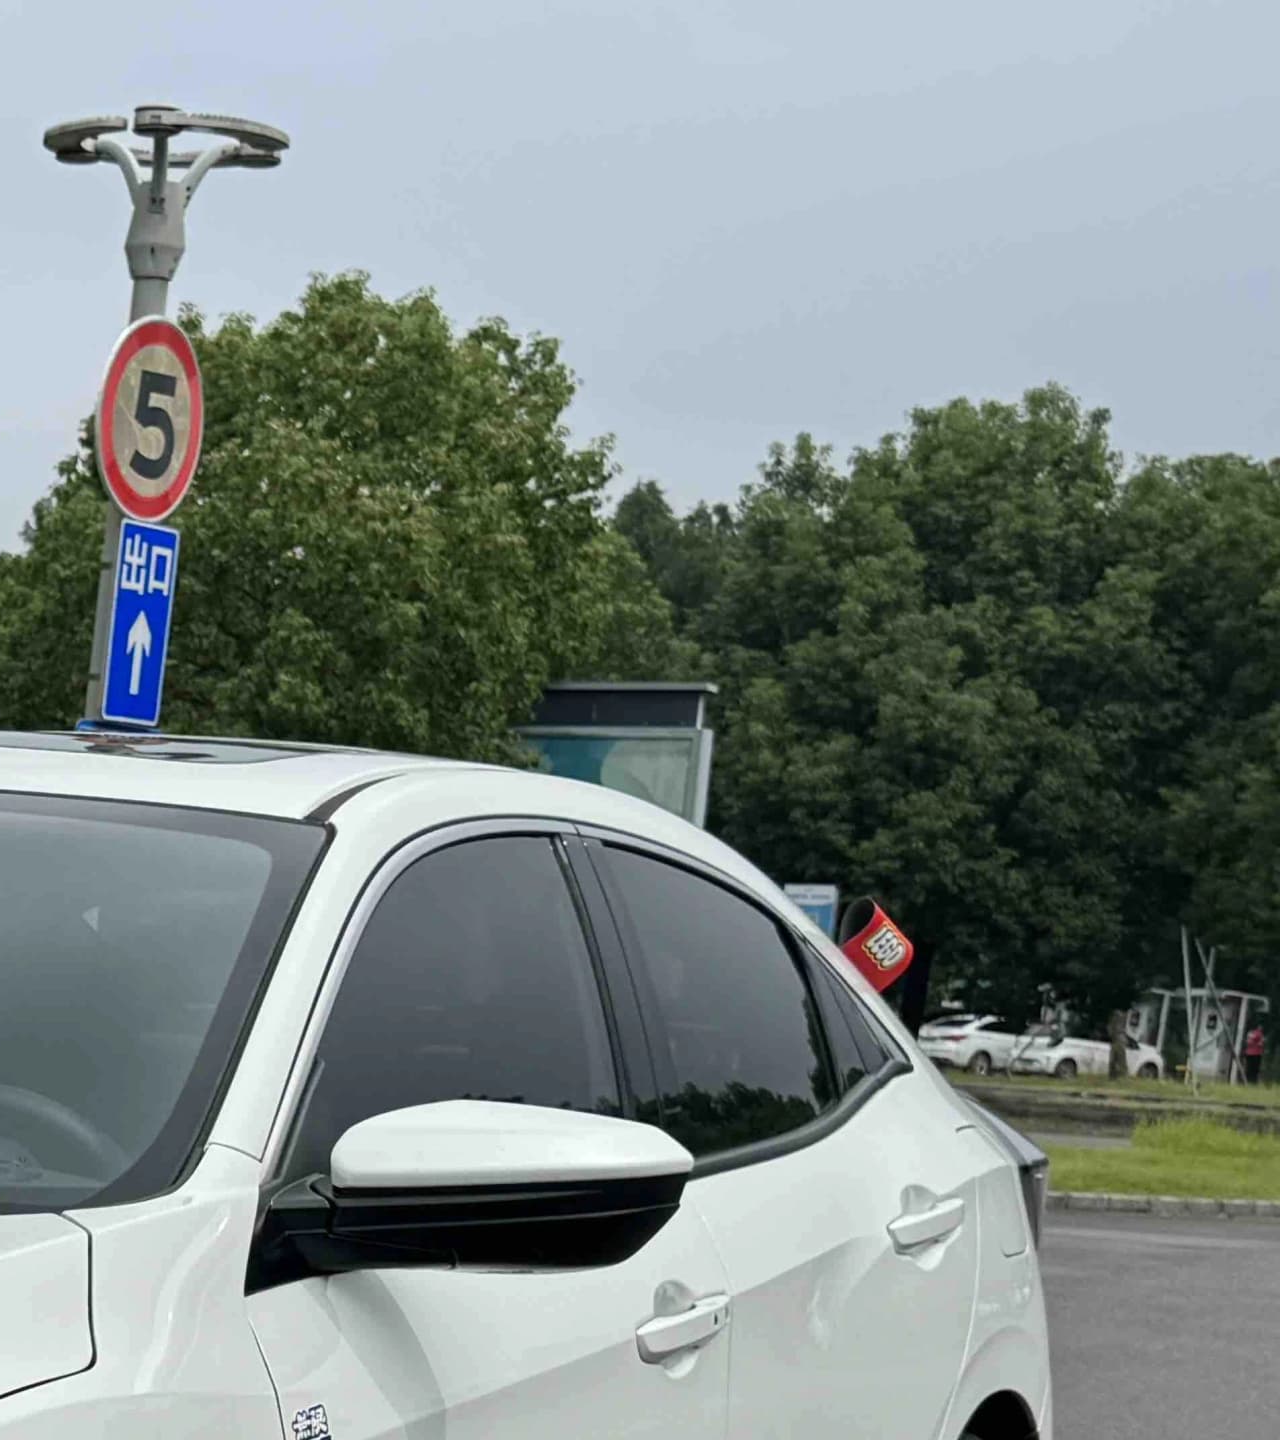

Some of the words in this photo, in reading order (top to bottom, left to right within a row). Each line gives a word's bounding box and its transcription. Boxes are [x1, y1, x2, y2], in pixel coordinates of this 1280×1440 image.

[130, 370, 177, 480] 5
[121, 534, 173, 596] 出口
[864, 926, 906, 968] LEGO
